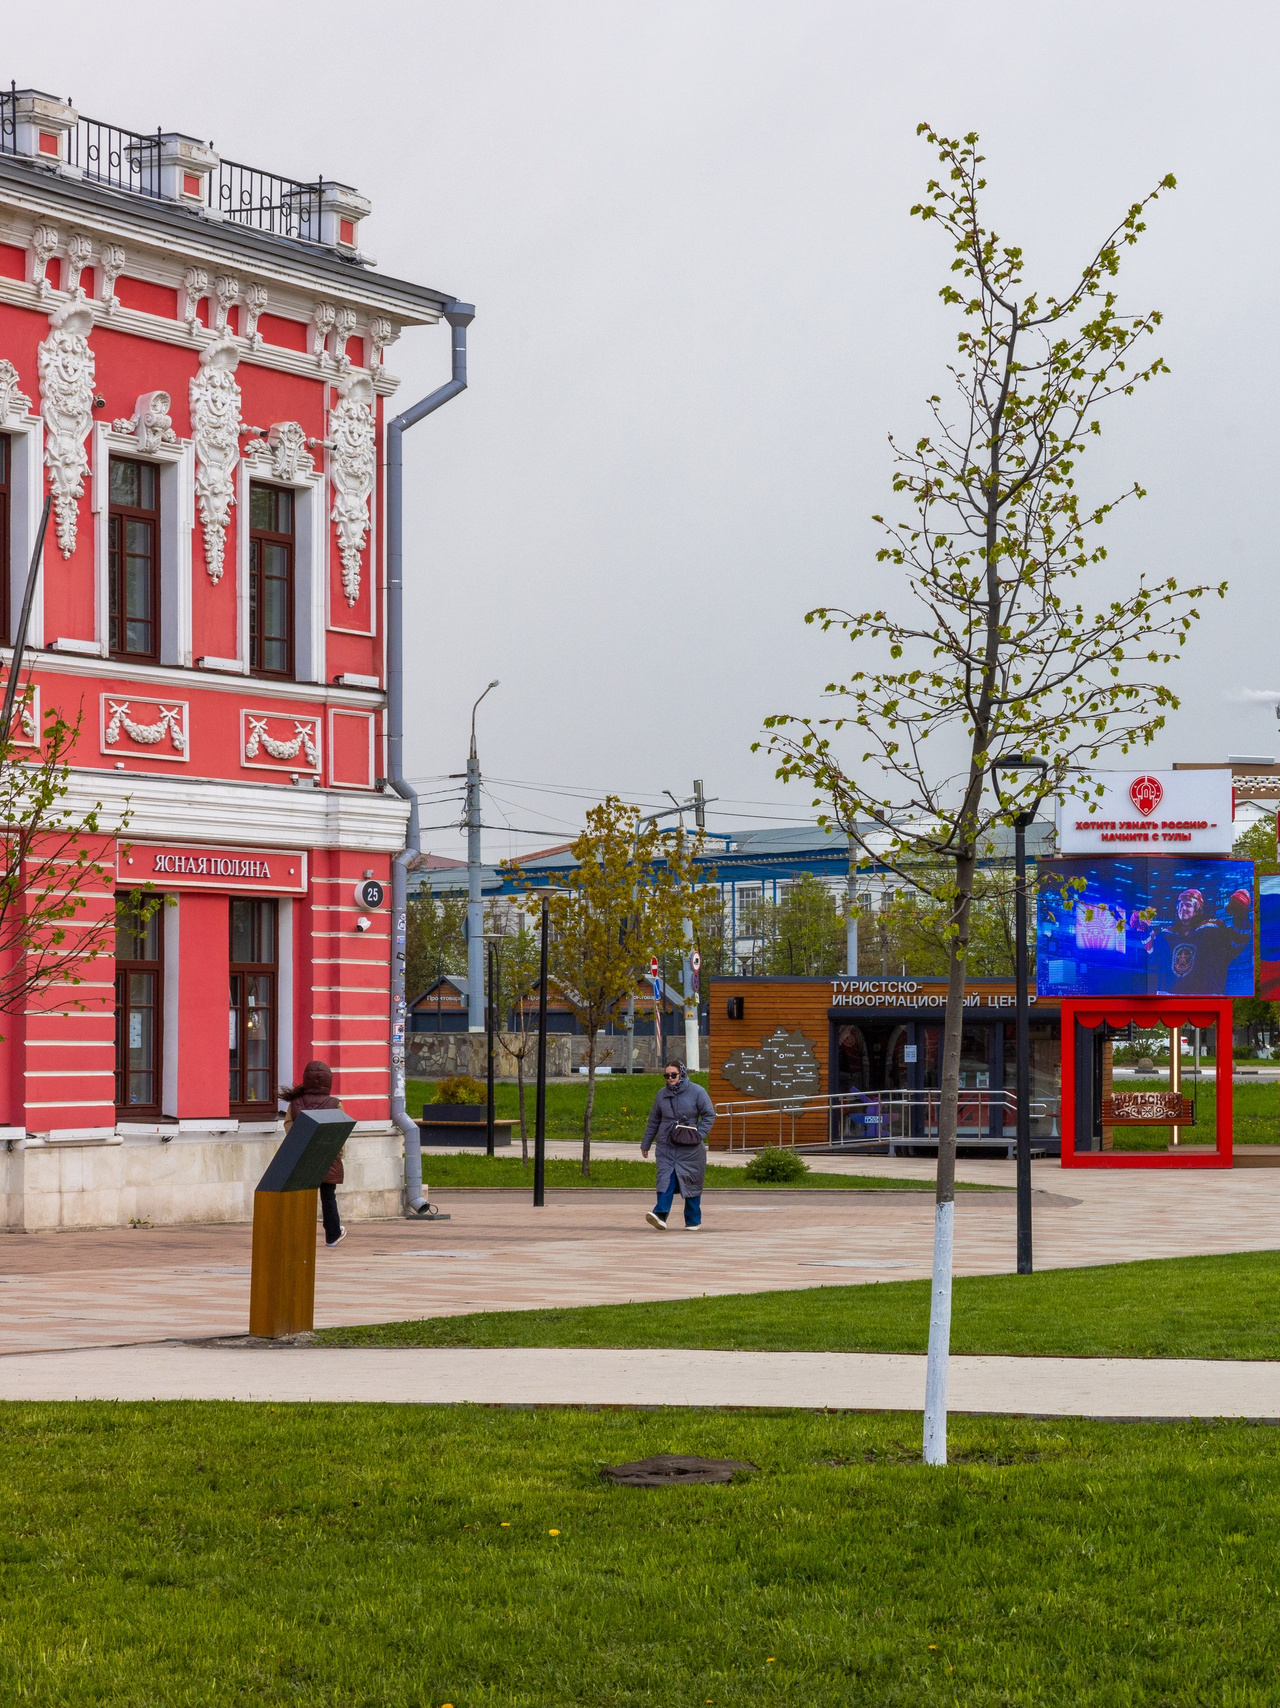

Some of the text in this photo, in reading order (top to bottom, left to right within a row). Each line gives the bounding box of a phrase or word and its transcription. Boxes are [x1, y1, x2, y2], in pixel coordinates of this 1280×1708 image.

[1075, 821, 1116, 830] ХОТИТЕ
[1119, 821, 1158, 830] УЗНАТЬ
[1161, 821, 1208, 830] РОССИЮ
[1101, 832, 1192, 842] НАЧНИТЕ С ТУЛЫ
[153, 854, 271, 878] ЯСНАЯ ПОЛЯНА
[367, 888, 379, 901] 25
[830, 981, 923, 993] ТУРИСТСКО-
[832, 992, 1037, 1008] ИНФОРМАЦИОНЫЙ ЦЕНР
